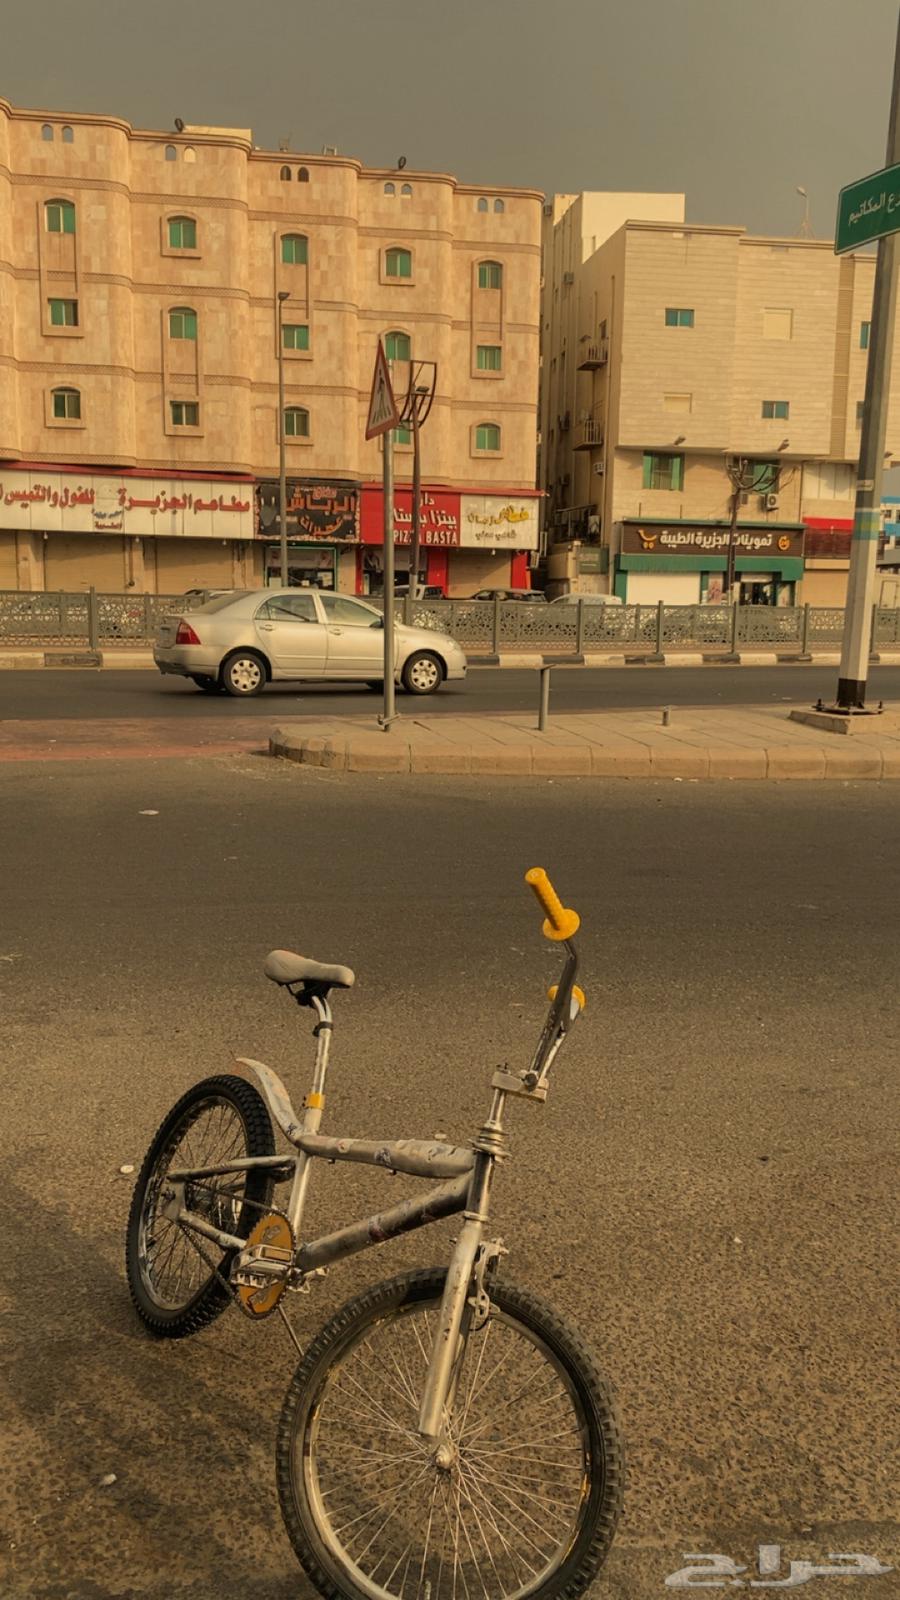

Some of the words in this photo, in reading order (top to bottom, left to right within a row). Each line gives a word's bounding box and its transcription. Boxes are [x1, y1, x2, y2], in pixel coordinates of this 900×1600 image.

[4, 484, 58, 509] والتميس
[59, 486, 94, 508] للفول
[118, 488, 192, 515] الجزيرة
[194, 494, 250, 515] مطاعم
[393, 508, 427, 528] بستا
[430, 509, 457, 529] بيتزا
[425, 530, 458, 544] BASTA
[660, 530, 695, 548] الطيبة
[695, 531, 730, 549] الجزيرة
[732, 533, 773, 549] تموينات
